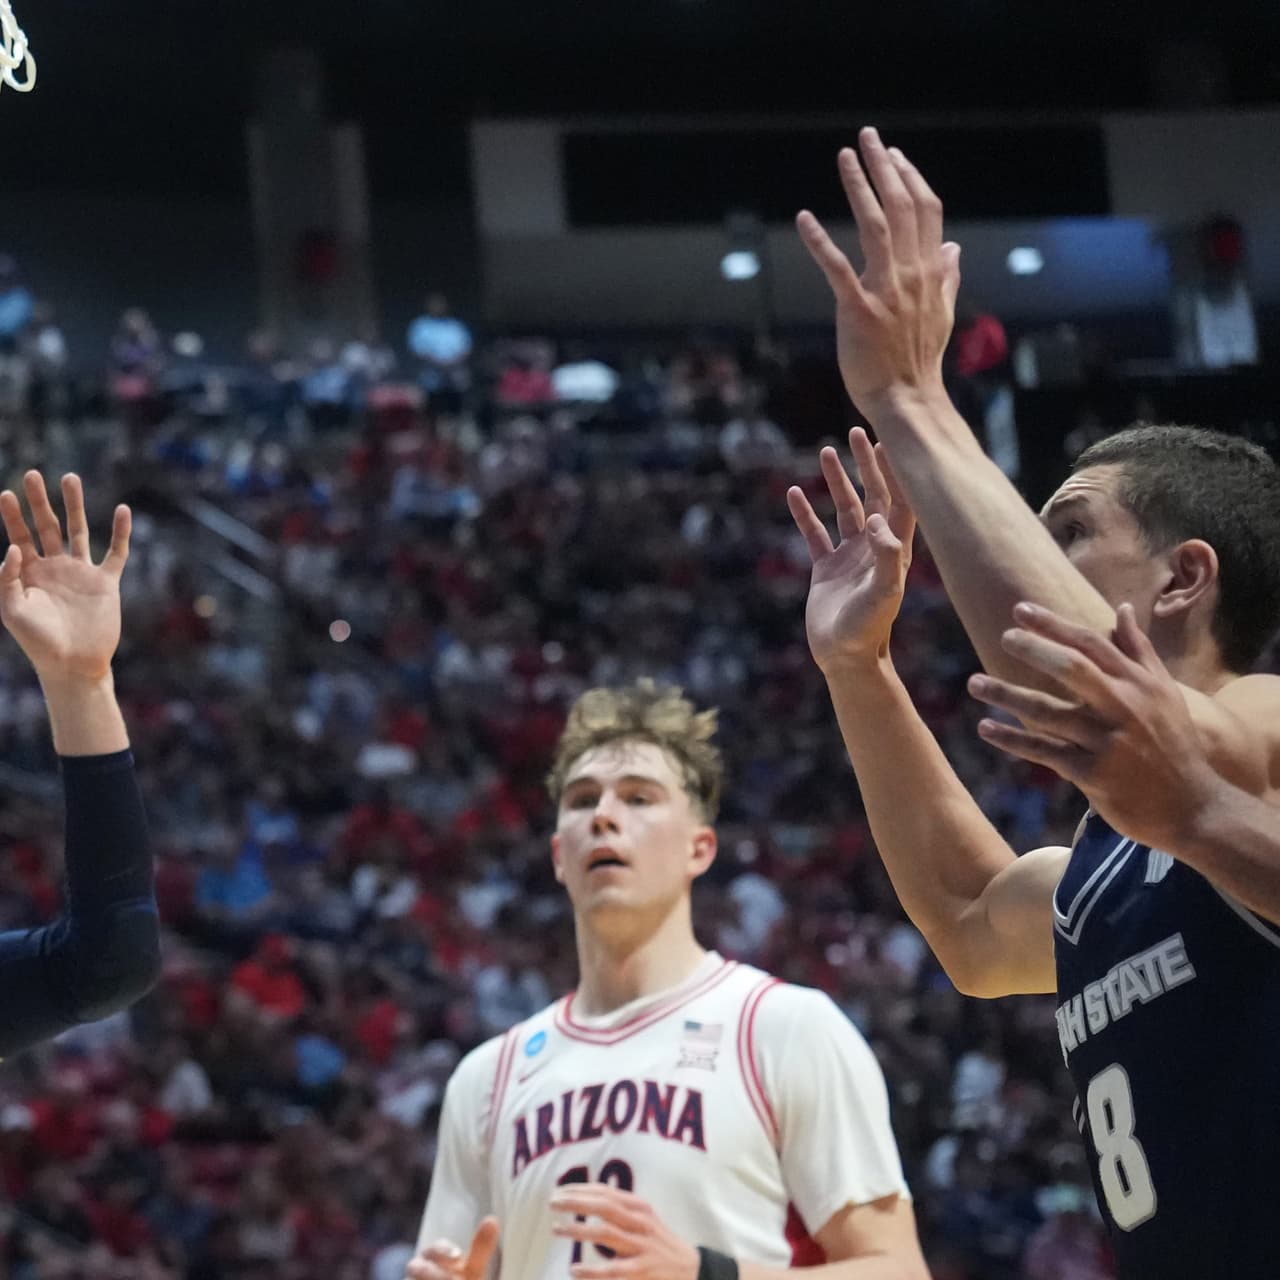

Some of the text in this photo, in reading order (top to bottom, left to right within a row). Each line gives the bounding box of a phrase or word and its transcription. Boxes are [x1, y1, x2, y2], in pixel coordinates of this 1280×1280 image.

[1083, 932, 1197, 1035] STATE
[512, 1079, 707, 1179] ARIZONA
[1073, 1062, 1157, 1233] 8
